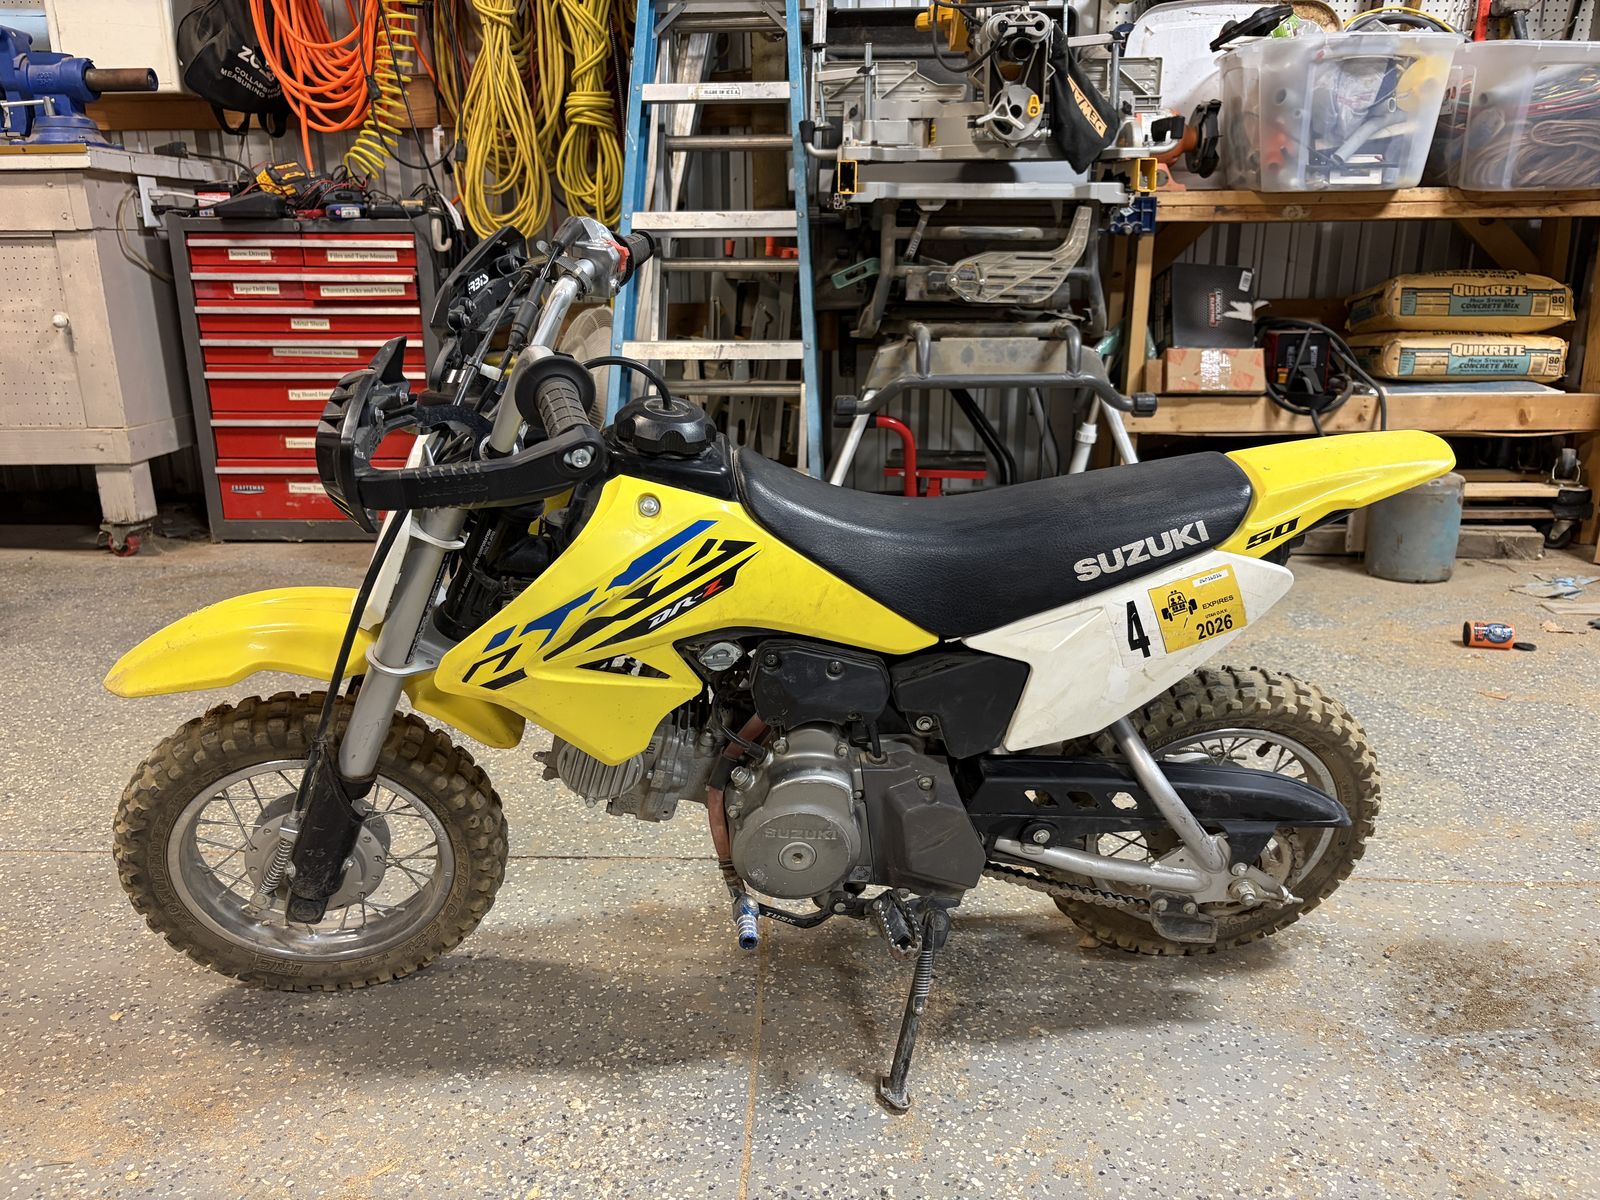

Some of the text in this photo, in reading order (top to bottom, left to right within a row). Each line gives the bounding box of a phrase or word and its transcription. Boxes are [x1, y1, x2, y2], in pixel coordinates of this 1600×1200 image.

[220, 67, 265, 98] MEASURING
[1452, 283, 1528, 297] QUIKRETE
[1552, 295, 1565, 304] 80
[1451, 343, 1526, 357] QUIKRETE
[1548, 356, 1560, 365] 80
[1245, 516, 1301, 550] 50
[477, 528, 493, 558] CORPORATION
[1073, 520, 1210, 582] SUZUKI
[648, 578, 723, 630] DR-Z
[1202, 594, 1234, 610] EXPIRES
[1205, 611, 1216, 619] UTAH
[1126, 600, 1151, 658] 4
[1196, 614, 1233, 641] 2026
[765, 827, 838, 841] SUZUKI
[765, 911, 797, 924] TUSK
